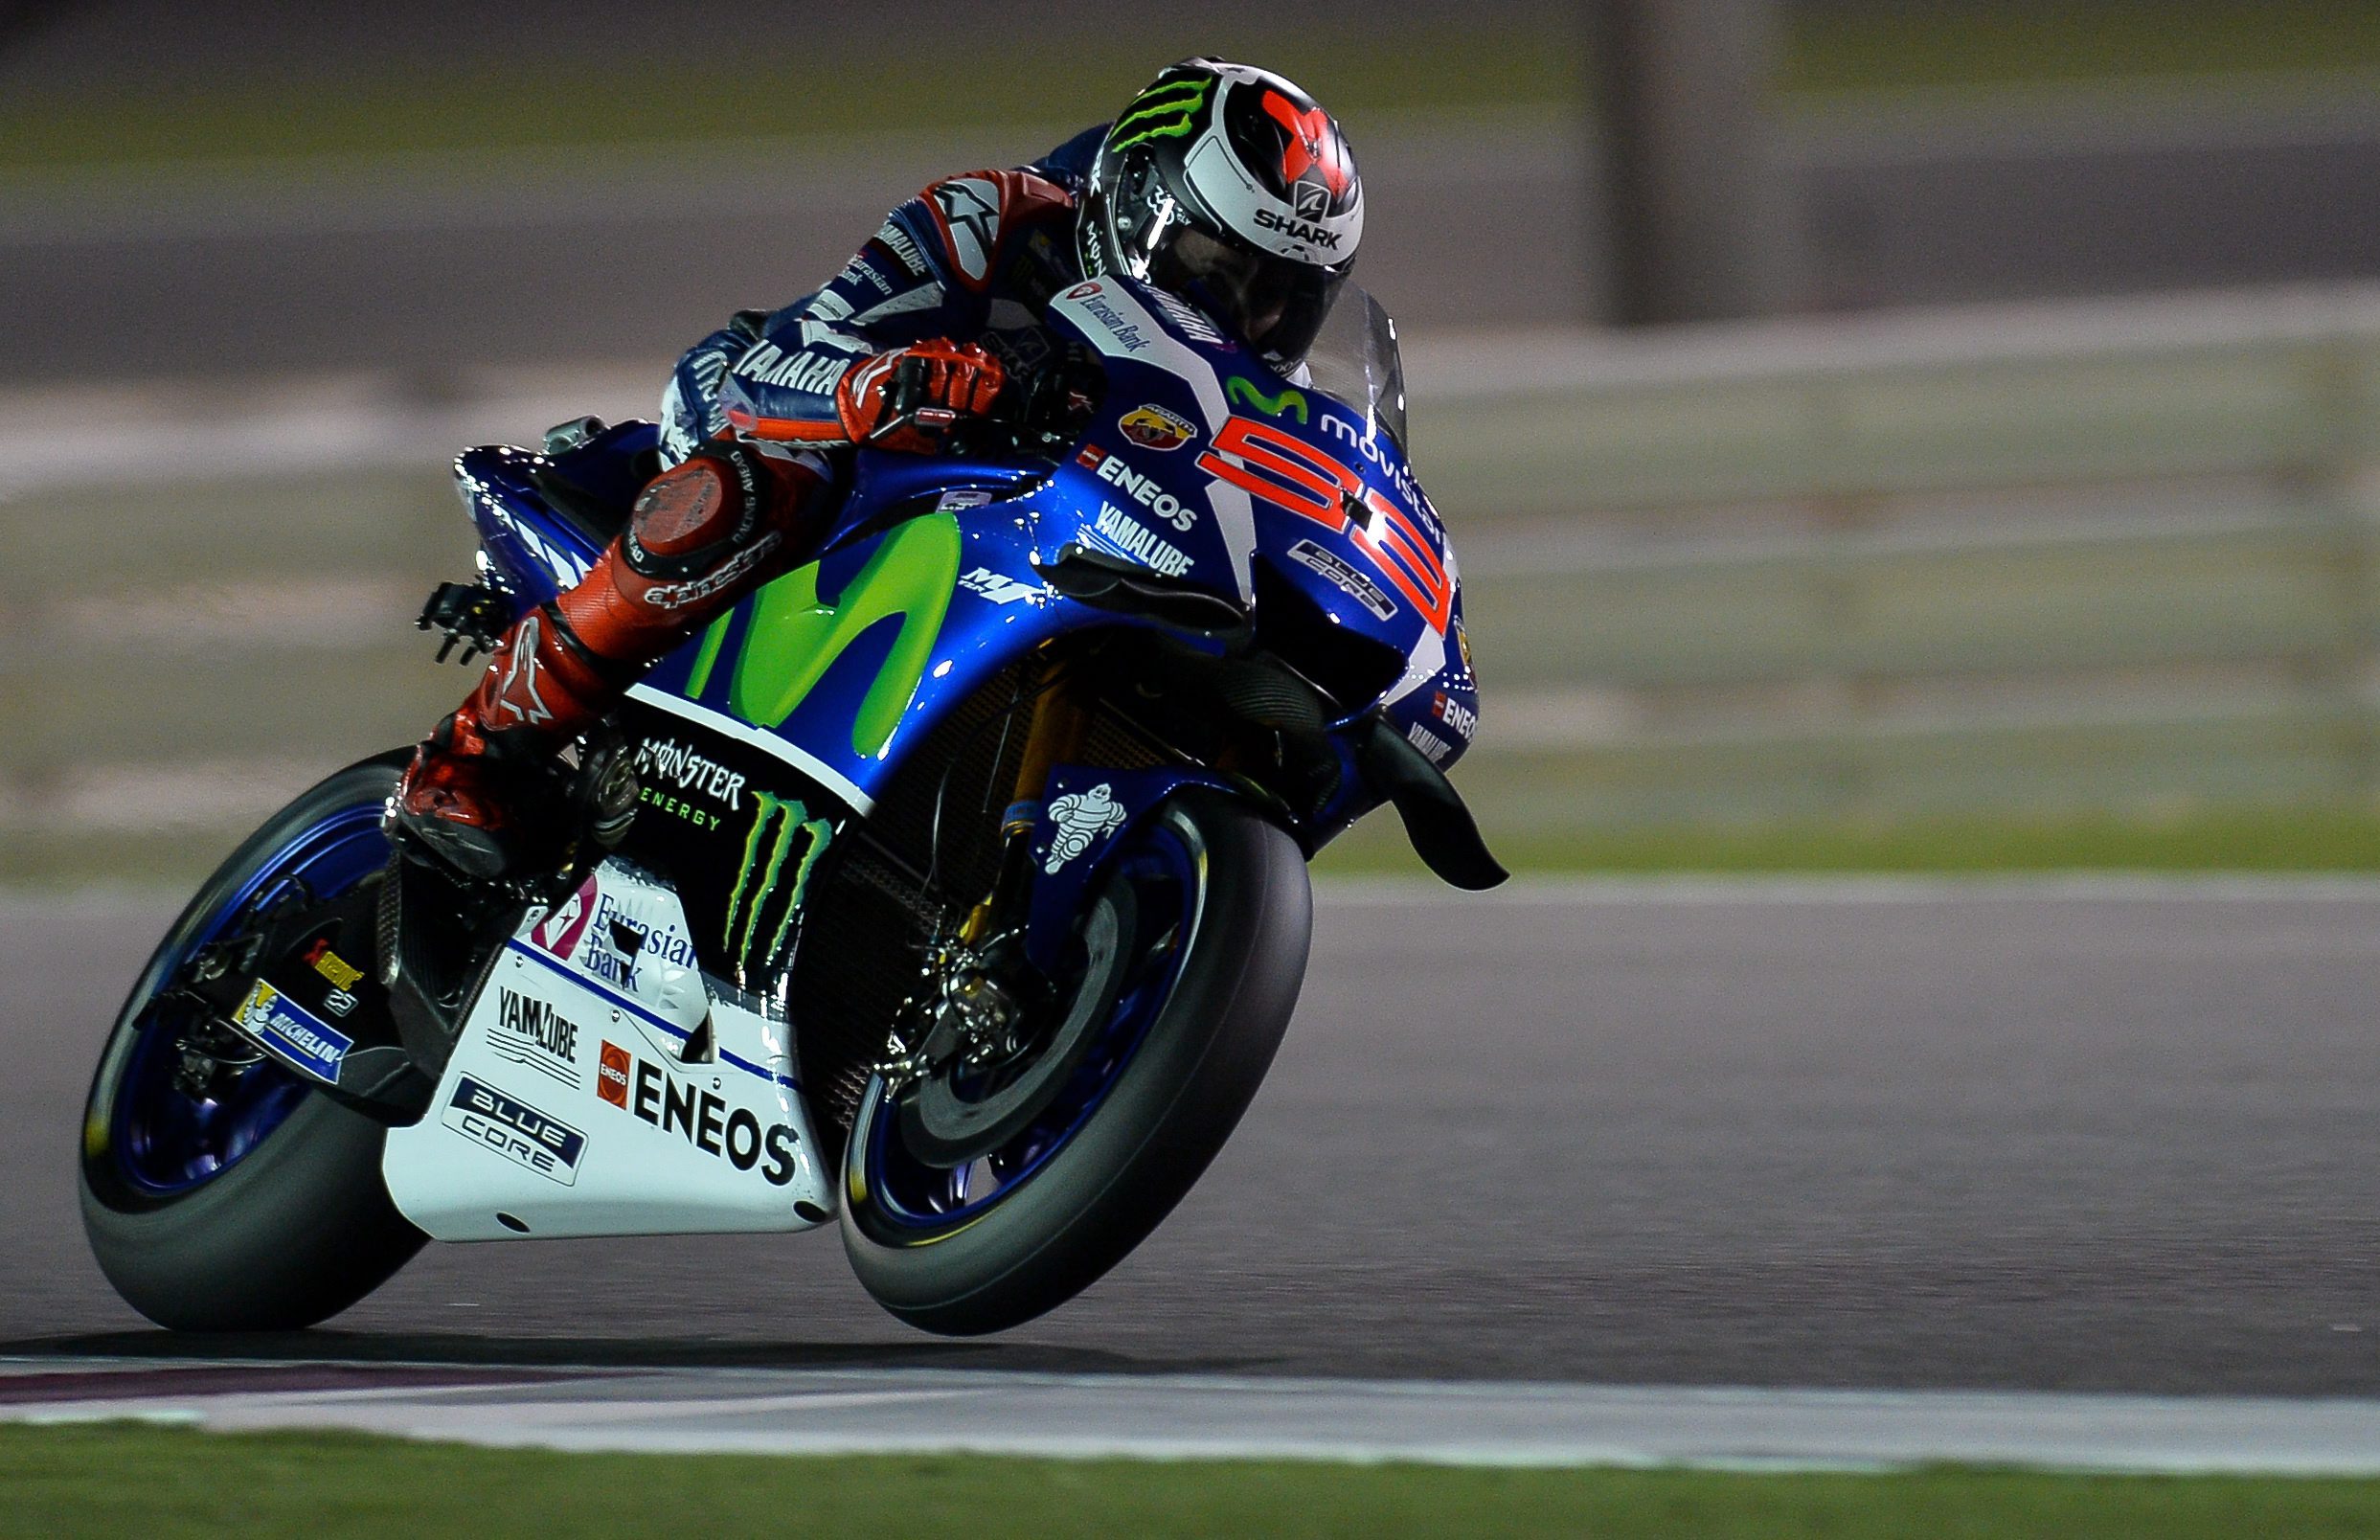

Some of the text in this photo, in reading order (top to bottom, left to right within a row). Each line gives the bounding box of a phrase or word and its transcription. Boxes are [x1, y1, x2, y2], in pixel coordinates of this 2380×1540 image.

[873, 219, 927, 276] AMALUBE
[1253, 209, 1343, 251] SHARK
[1112, 325, 1150, 352] Bank
[1096, 454, 1198, 532] ENEOS
[1094, 500, 1195, 578] YAMALUBE
[1442, 696, 1476, 744] ENEO
[634, 736, 746, 811] MONSTER
[640, 786, 721, 831] ENERGY
[269, 1011, 343, 1064] MICHELIN
[499, 985, 579, 1065] YAMLUBE
[462, 1115, 555, 1173] CORE
[472, 1088, 567, 1148] BLUE
[601, 1057, 801, 1187] ENEOS ENEOS
